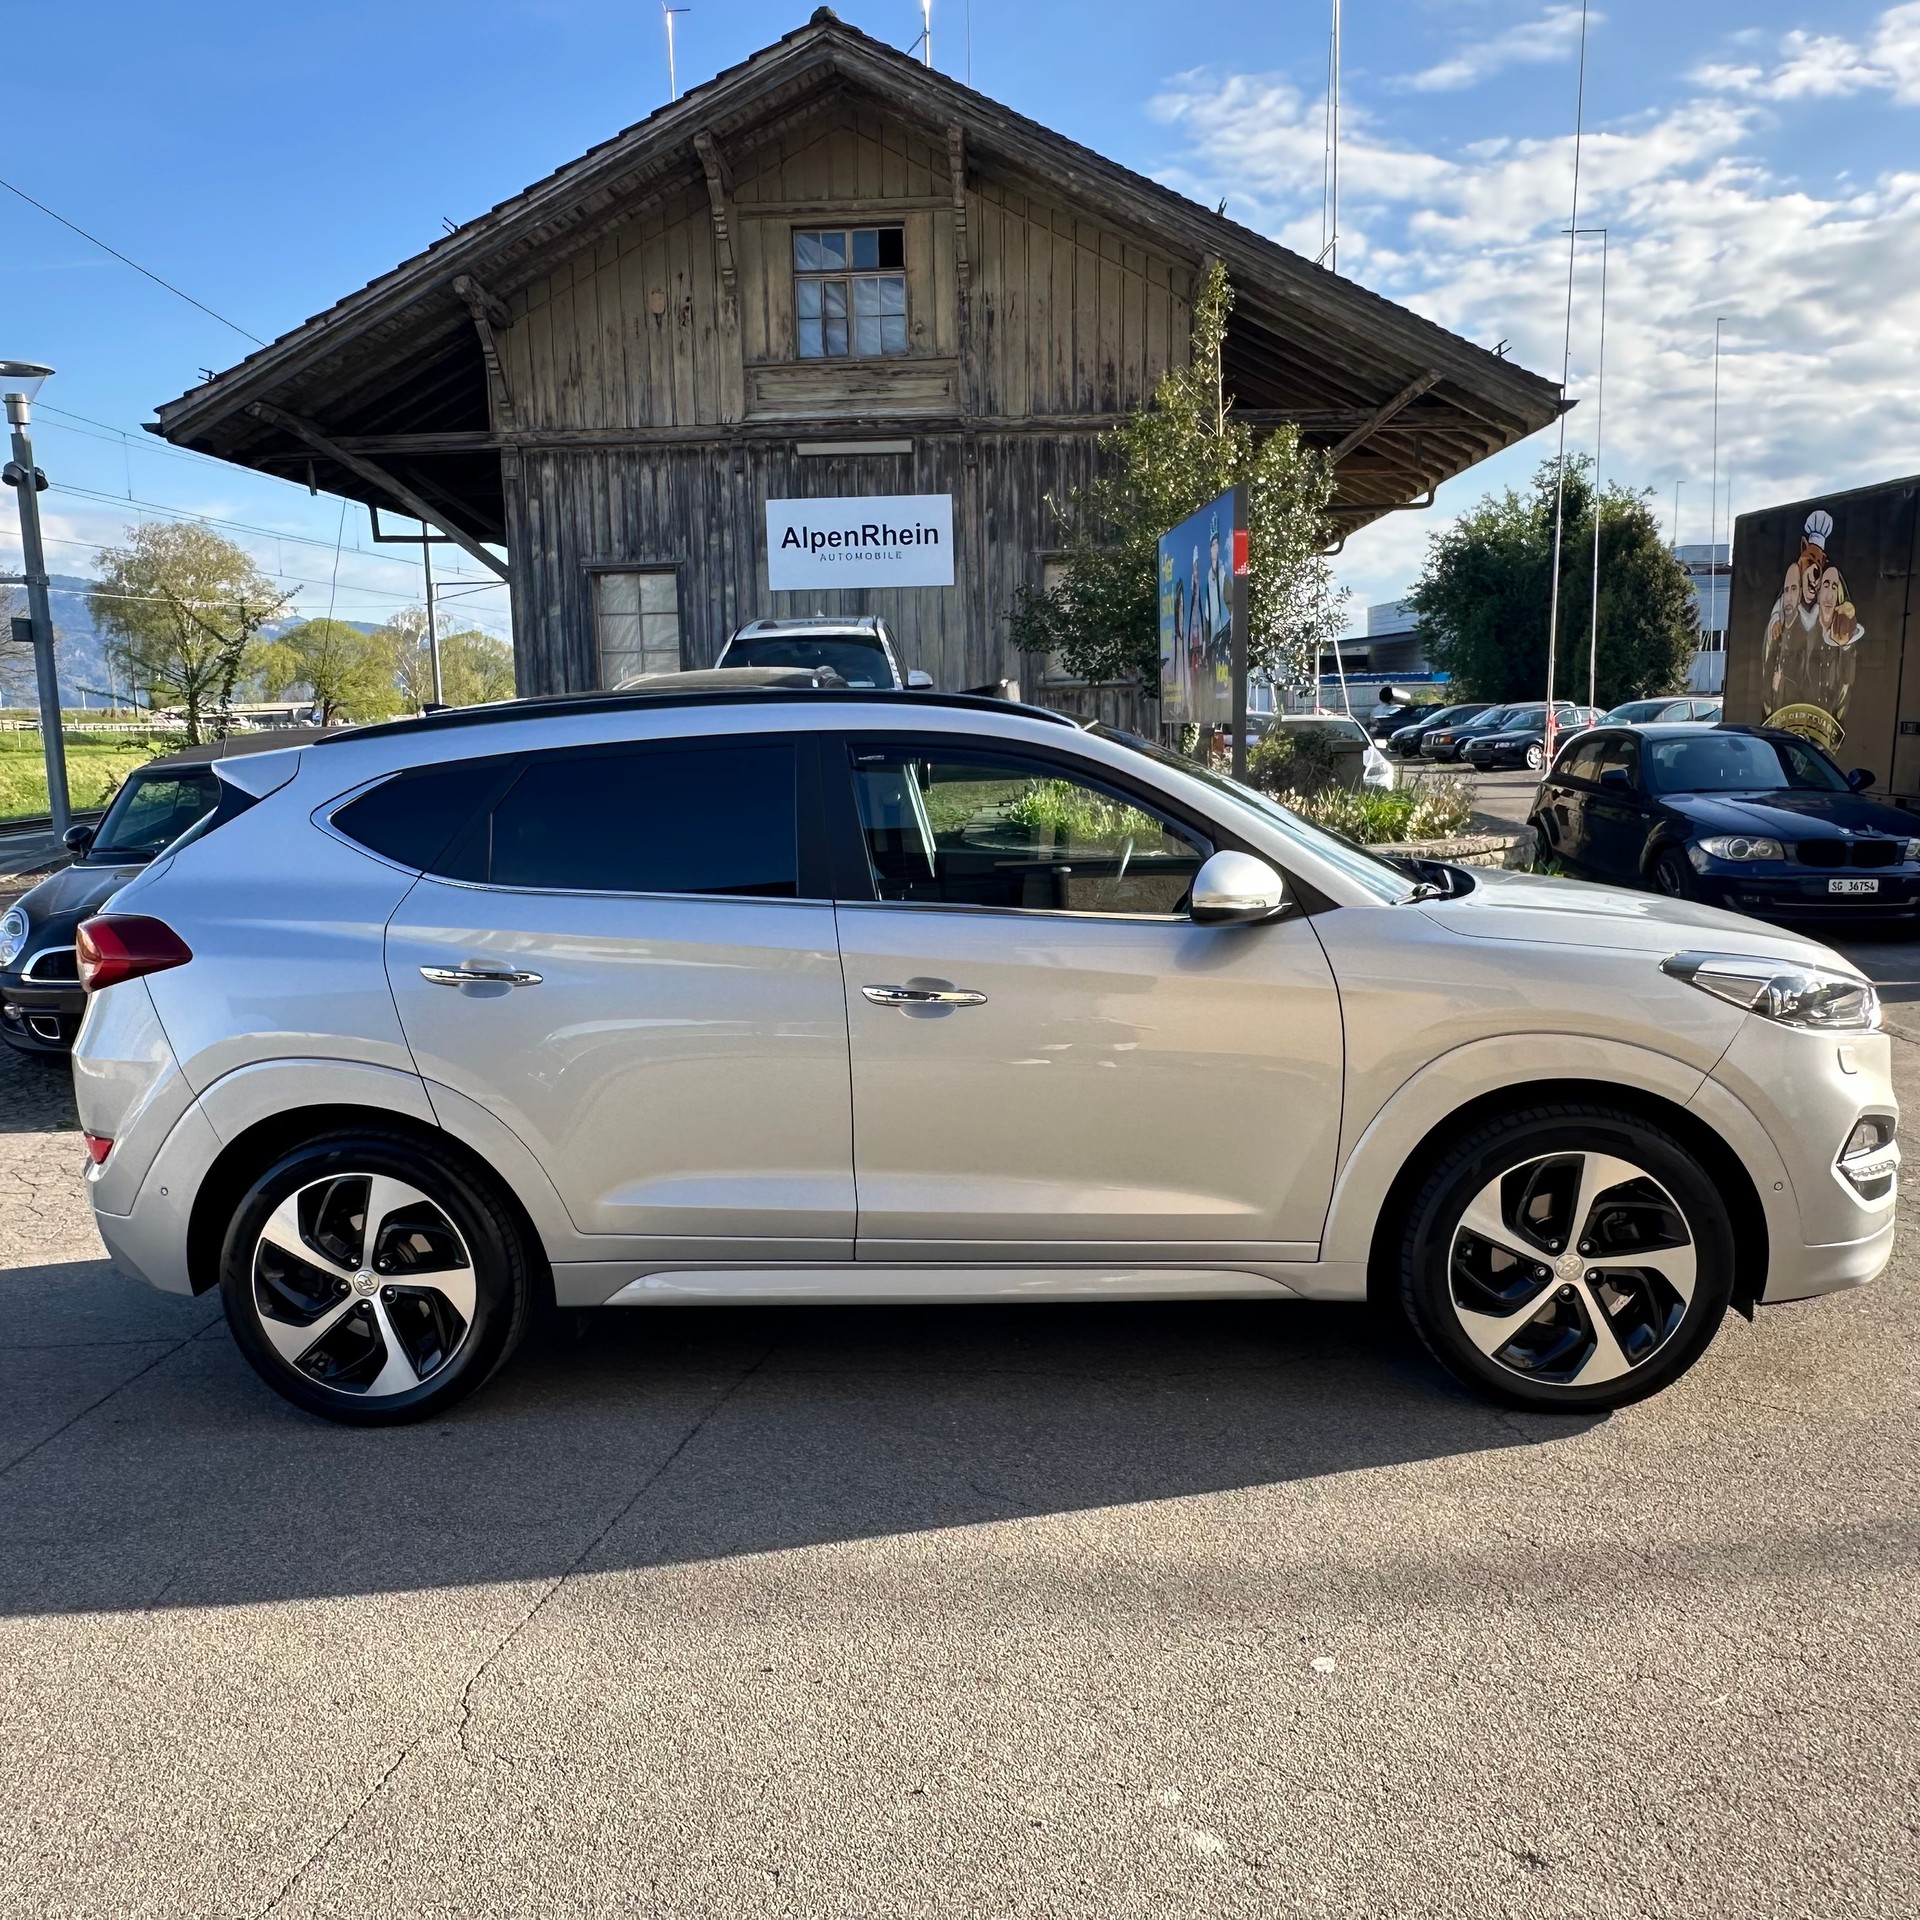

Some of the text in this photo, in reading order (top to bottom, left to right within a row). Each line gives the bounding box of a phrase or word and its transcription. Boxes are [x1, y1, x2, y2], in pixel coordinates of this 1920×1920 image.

[781, 523, 939, 553] AlpenRhein
[820, 551, 902, 562] AUTOMOBILE
[1831, 881, 1843, 891] SG
